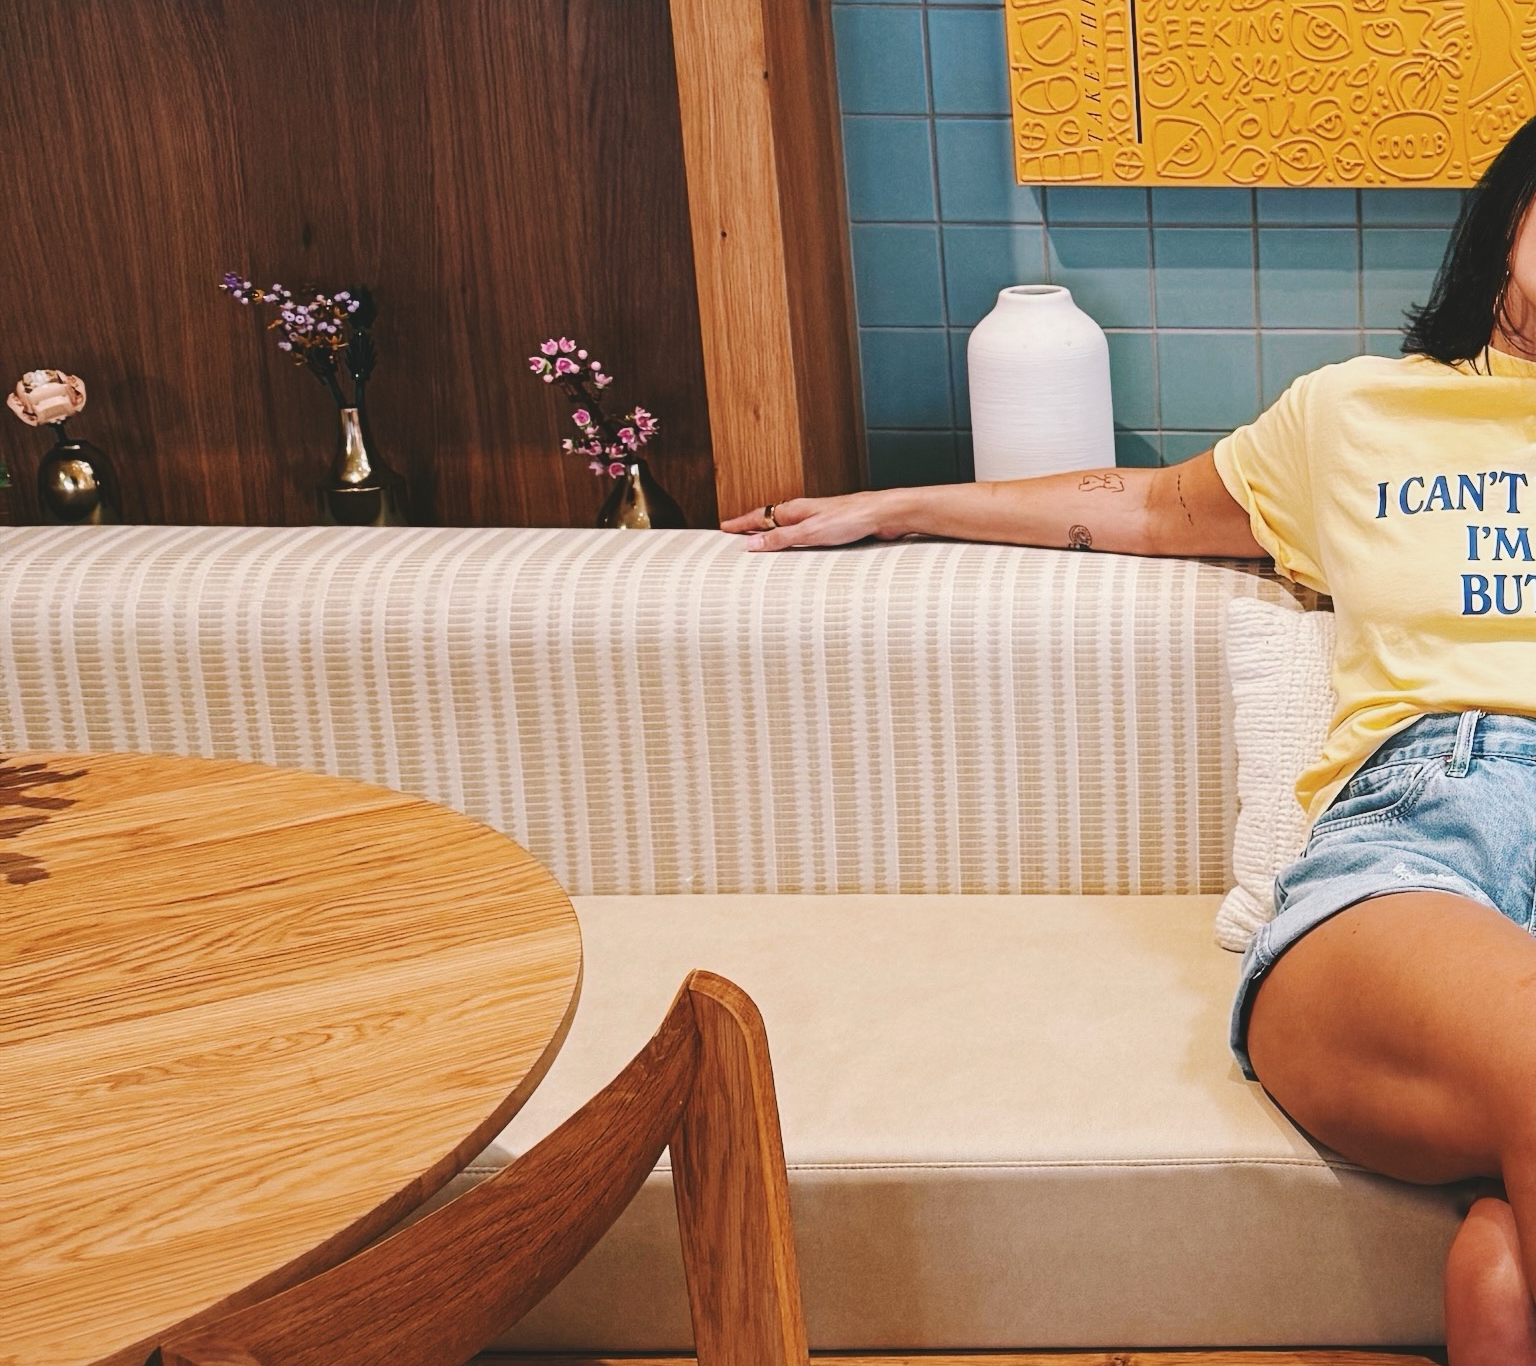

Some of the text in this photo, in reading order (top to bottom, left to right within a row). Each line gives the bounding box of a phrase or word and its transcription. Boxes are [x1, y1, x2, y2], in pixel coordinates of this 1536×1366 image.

[1084, 66, 1105, 144] TAKE
[1374, 481, 1390, 520] I
[1398, 469, 1528, 517] CAN'T
[1465, 522, 1535, 563] I'M
